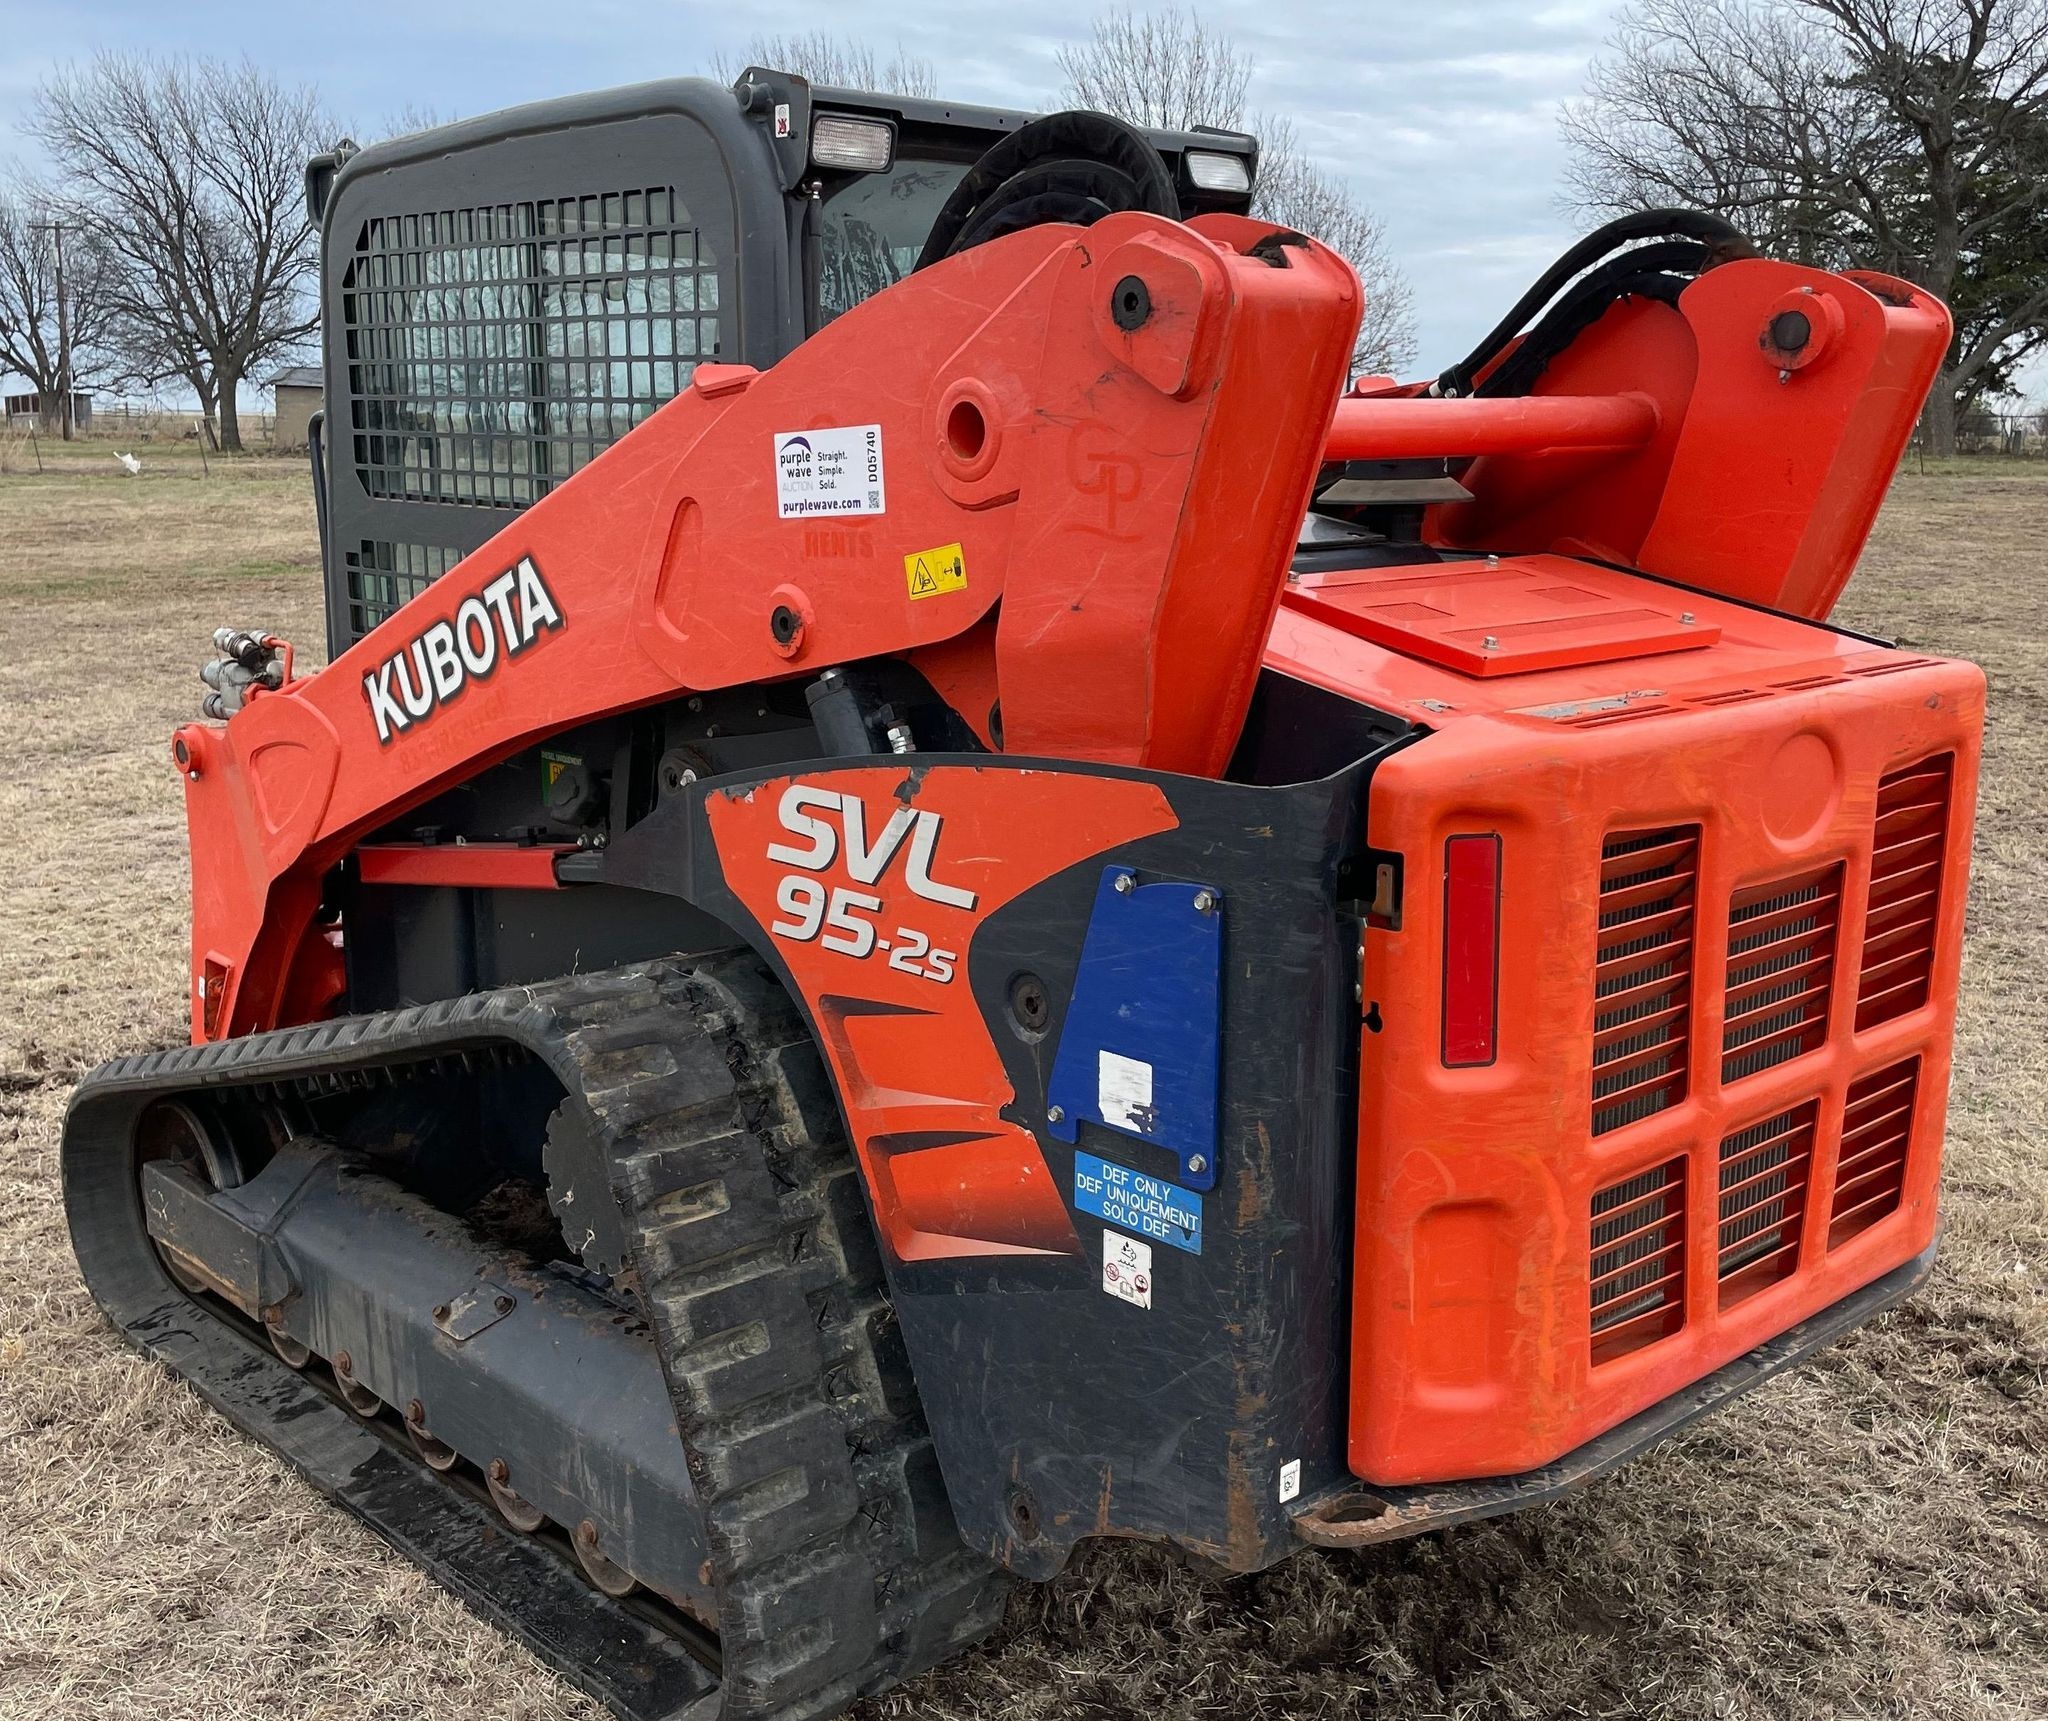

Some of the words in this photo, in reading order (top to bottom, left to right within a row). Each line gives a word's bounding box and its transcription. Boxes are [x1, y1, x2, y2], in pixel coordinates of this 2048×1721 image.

[780, 450, 811, 468] purple
[817, 449, 848, 463] Straight.
[866, 431, 878, 482] DQ5740
[787, 467, 812, 478] wave
[818, 465, 845, 477] Simple.
[782, 480, 813, 492] AUCTION
[819, 479, 837, 490] Sold.
[783, 498, 862, 515] purplewave.com
[362, 555, 562, 744] KUBOTA
[765, 784, 980, 913] SVL
[1103, 1164, 1130, 1186] DEF
[1134, 1177, 1171, 1202] ONLY
[1077, 1173, 1103, 1194] DEF
[1107, 1184, 1199, 1231] UNIQUEMENT
[1102, 1201, 1139, 1227] SOLO
[1143, 1215, 1171, 1238] DEF
